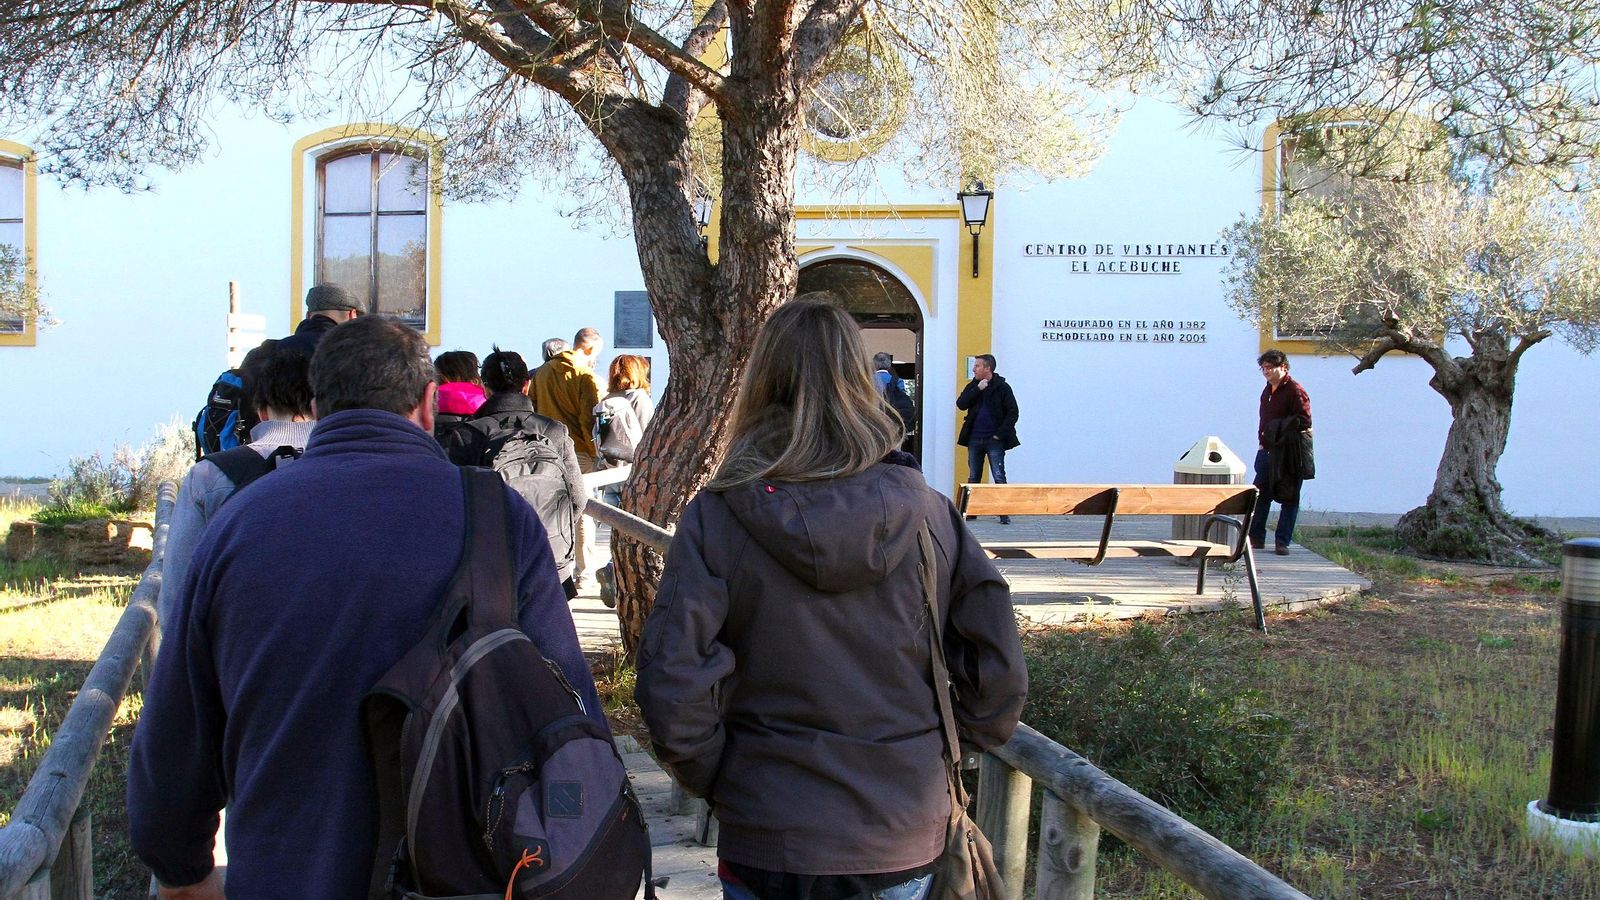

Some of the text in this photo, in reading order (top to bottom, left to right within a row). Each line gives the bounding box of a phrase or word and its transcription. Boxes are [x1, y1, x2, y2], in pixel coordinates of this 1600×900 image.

[1025, 244, 1229, 256] CENTRO DE VISITANTES
[1071, 261, 1181, 273] EL ACEBUCHE
[1044, 320, 1206, 329] INAUGURADO EN EL AÑO 1982
[1042, 332, 1114, 341] REMODELADO
[1119, 333, 1132, 341] EN
[1153, 333, 1174, 342] AÑO
[1179, 334, 1207, 342] 2004
